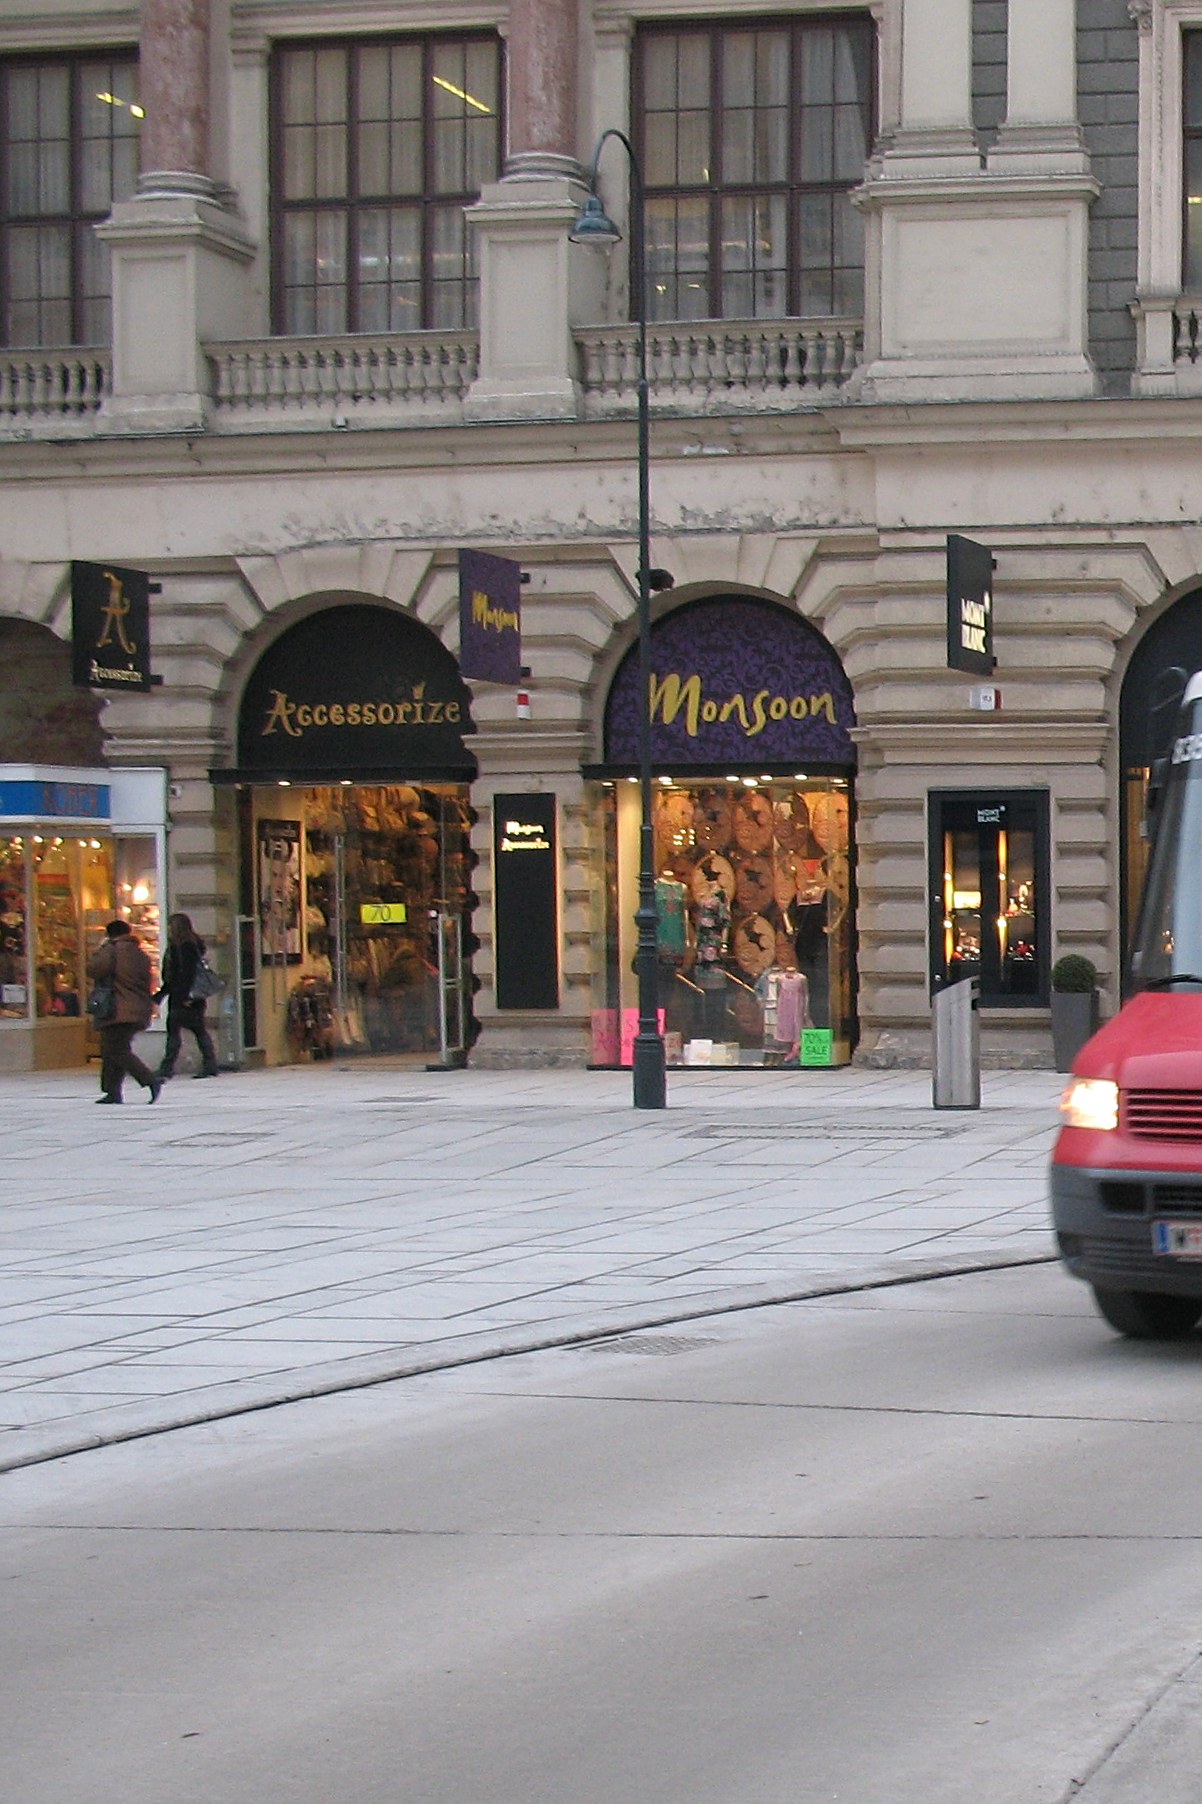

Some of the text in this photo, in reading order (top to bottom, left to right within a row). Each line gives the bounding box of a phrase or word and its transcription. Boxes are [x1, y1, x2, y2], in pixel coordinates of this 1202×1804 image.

[961, 597, 985, 628] MONT
[961, 623, 986, 654] BLANC
[261, 680, 462, 737] Accessorize
[649, 672, 838, 737] Monsoon
